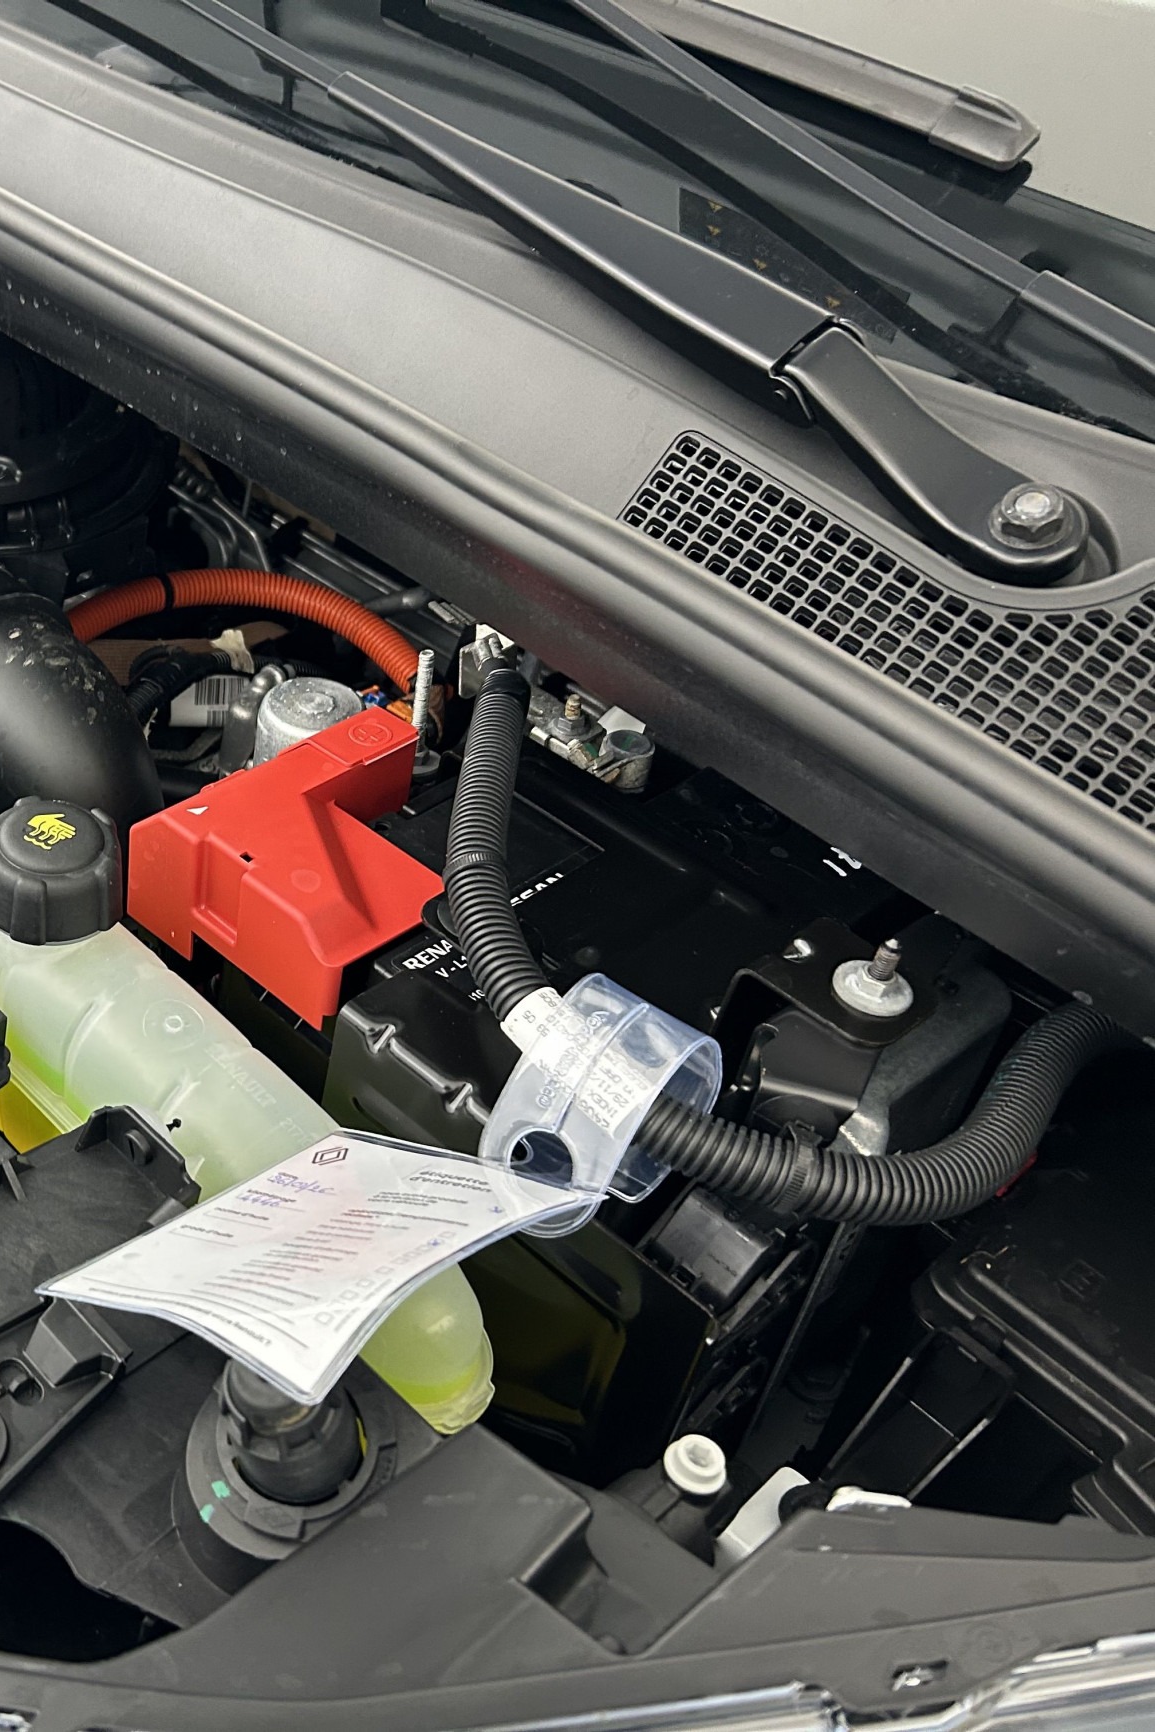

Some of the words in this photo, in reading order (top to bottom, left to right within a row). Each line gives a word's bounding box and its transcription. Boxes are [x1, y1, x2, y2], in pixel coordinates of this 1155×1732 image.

[402, 938, 454, 970] RENA
[435, 967, 450, 979] V
[589, 1089, 620, 1118] INDEX
